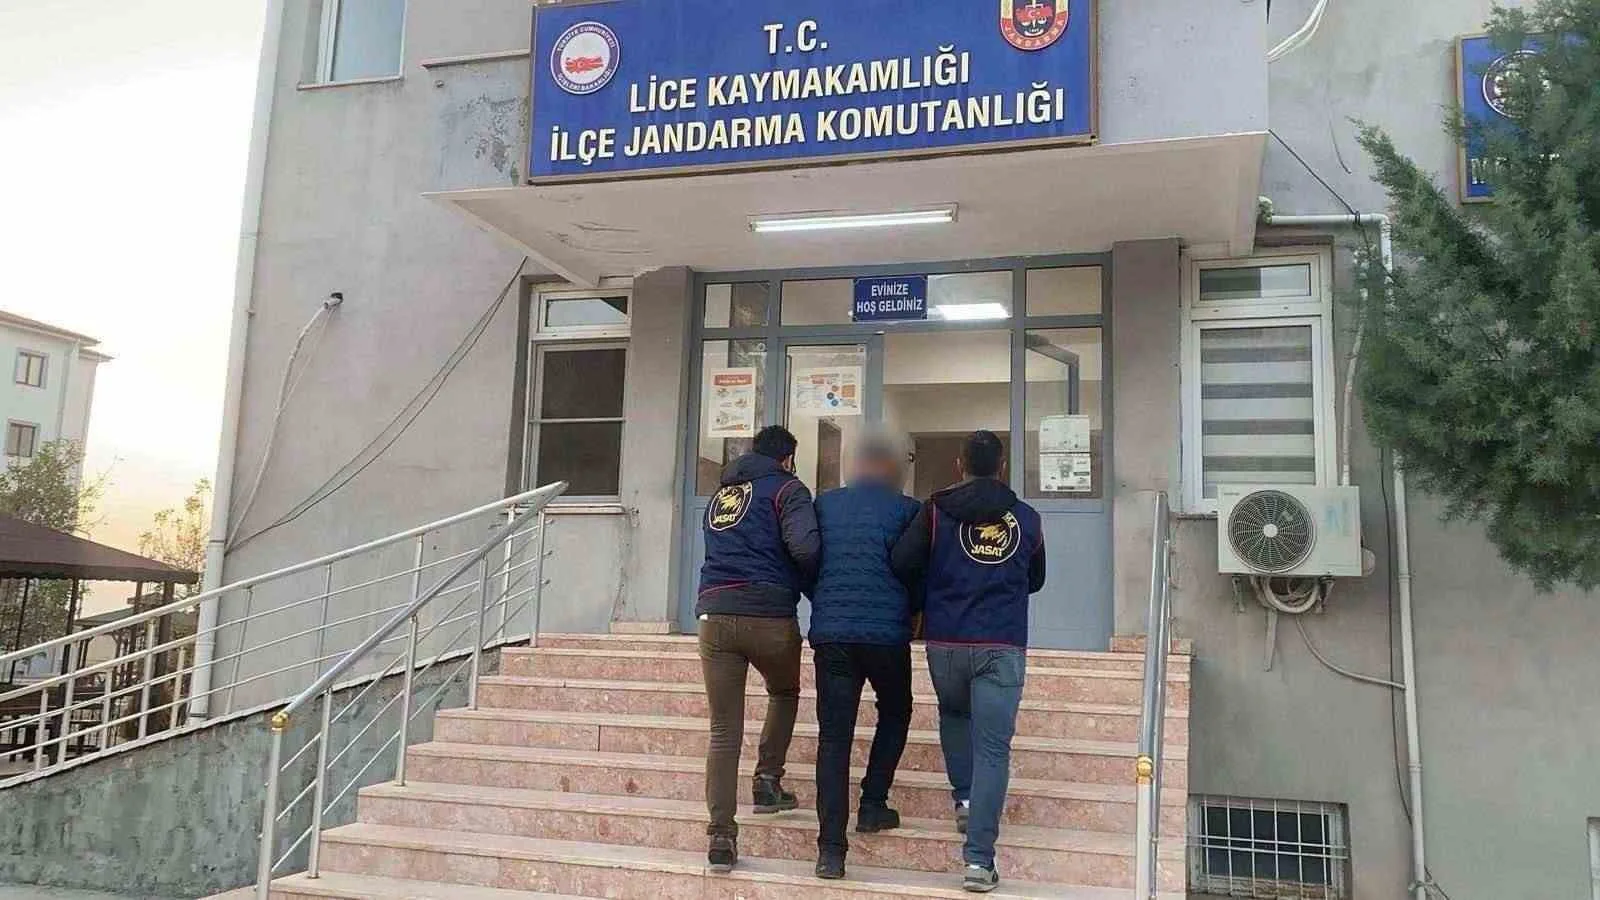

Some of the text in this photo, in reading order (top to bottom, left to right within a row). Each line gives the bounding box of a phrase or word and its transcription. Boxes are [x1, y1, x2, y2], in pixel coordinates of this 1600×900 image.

[763, 21, 829, 54] T.C.
[629, 45, 969, 113] LİCE KAYMAKAMLIĞI
[550, 81, 1065, 166] İLÇE JANDARMA KOMUTANLIĞI
[871, 281, 909, 297] EVİNİZE
[856, 296, 923, 315] HOŞ GELDİNİZ
[971, 544, 1003, 557] JASAT
